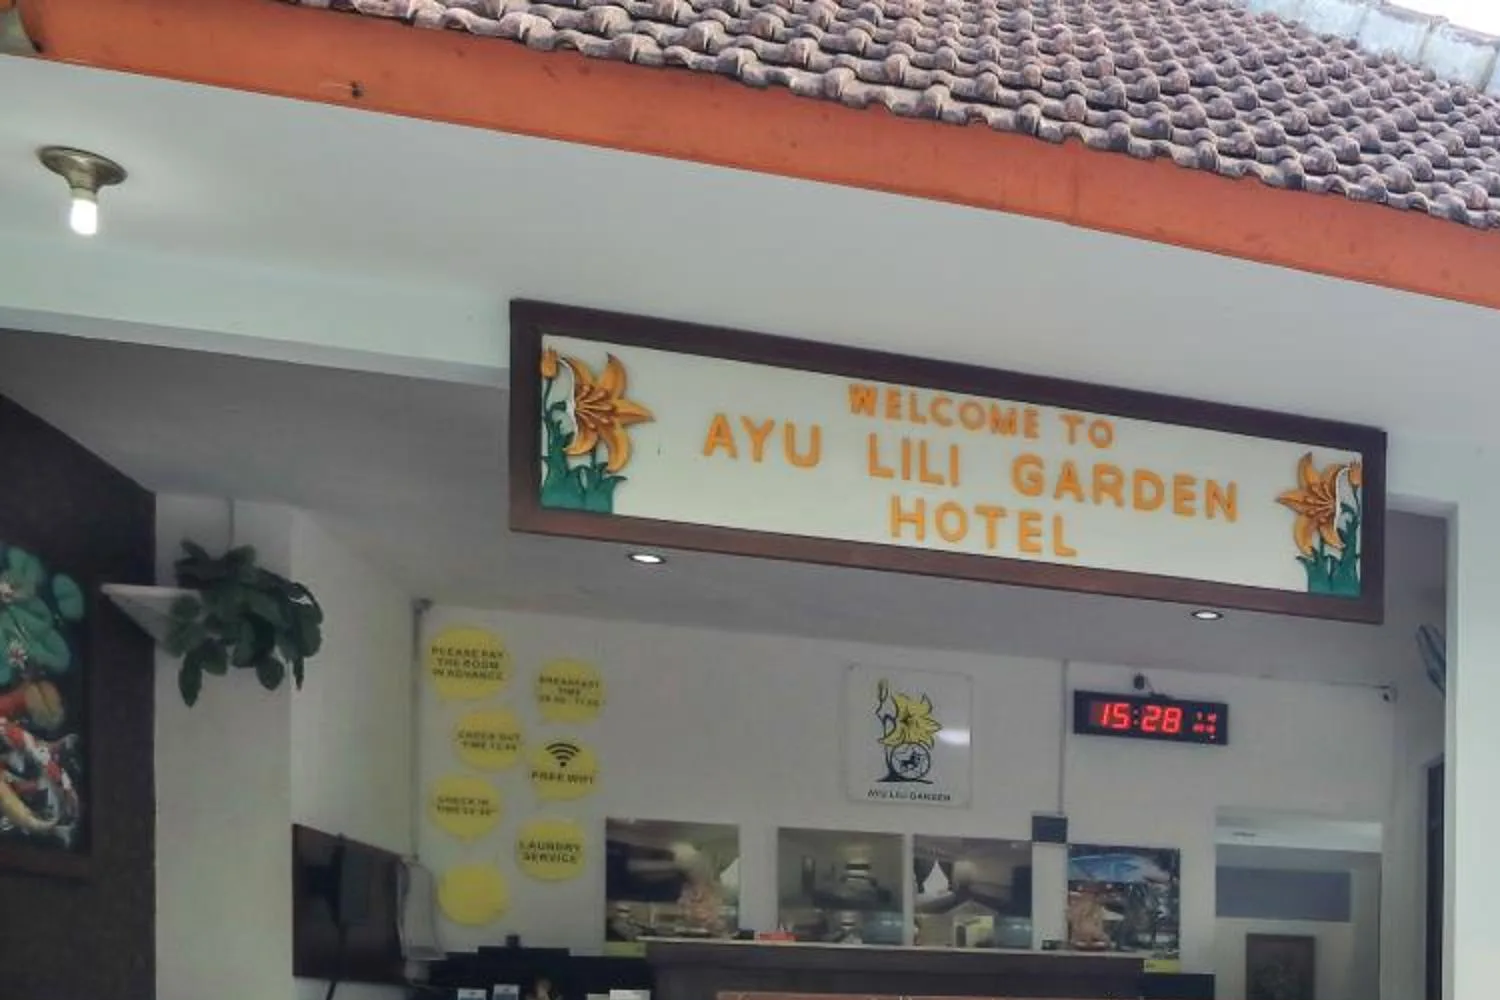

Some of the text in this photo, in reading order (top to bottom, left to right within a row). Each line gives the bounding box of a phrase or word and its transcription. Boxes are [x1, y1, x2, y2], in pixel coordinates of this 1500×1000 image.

[848, 383, 1115, 449] WELCOME TO
[703, 412, 1238, 523] AYU LILI GARDEN
[890, 495, 1077, 557] HOTEL
[431, 646, 479, 658] PLEASE
[1101, 702, 1183, 733] 15:28
[531, 771, 563, 782] FREE
[518, 840, 581, 852] LAUNDRY
[522, 851, 578, 864] SERVICE
